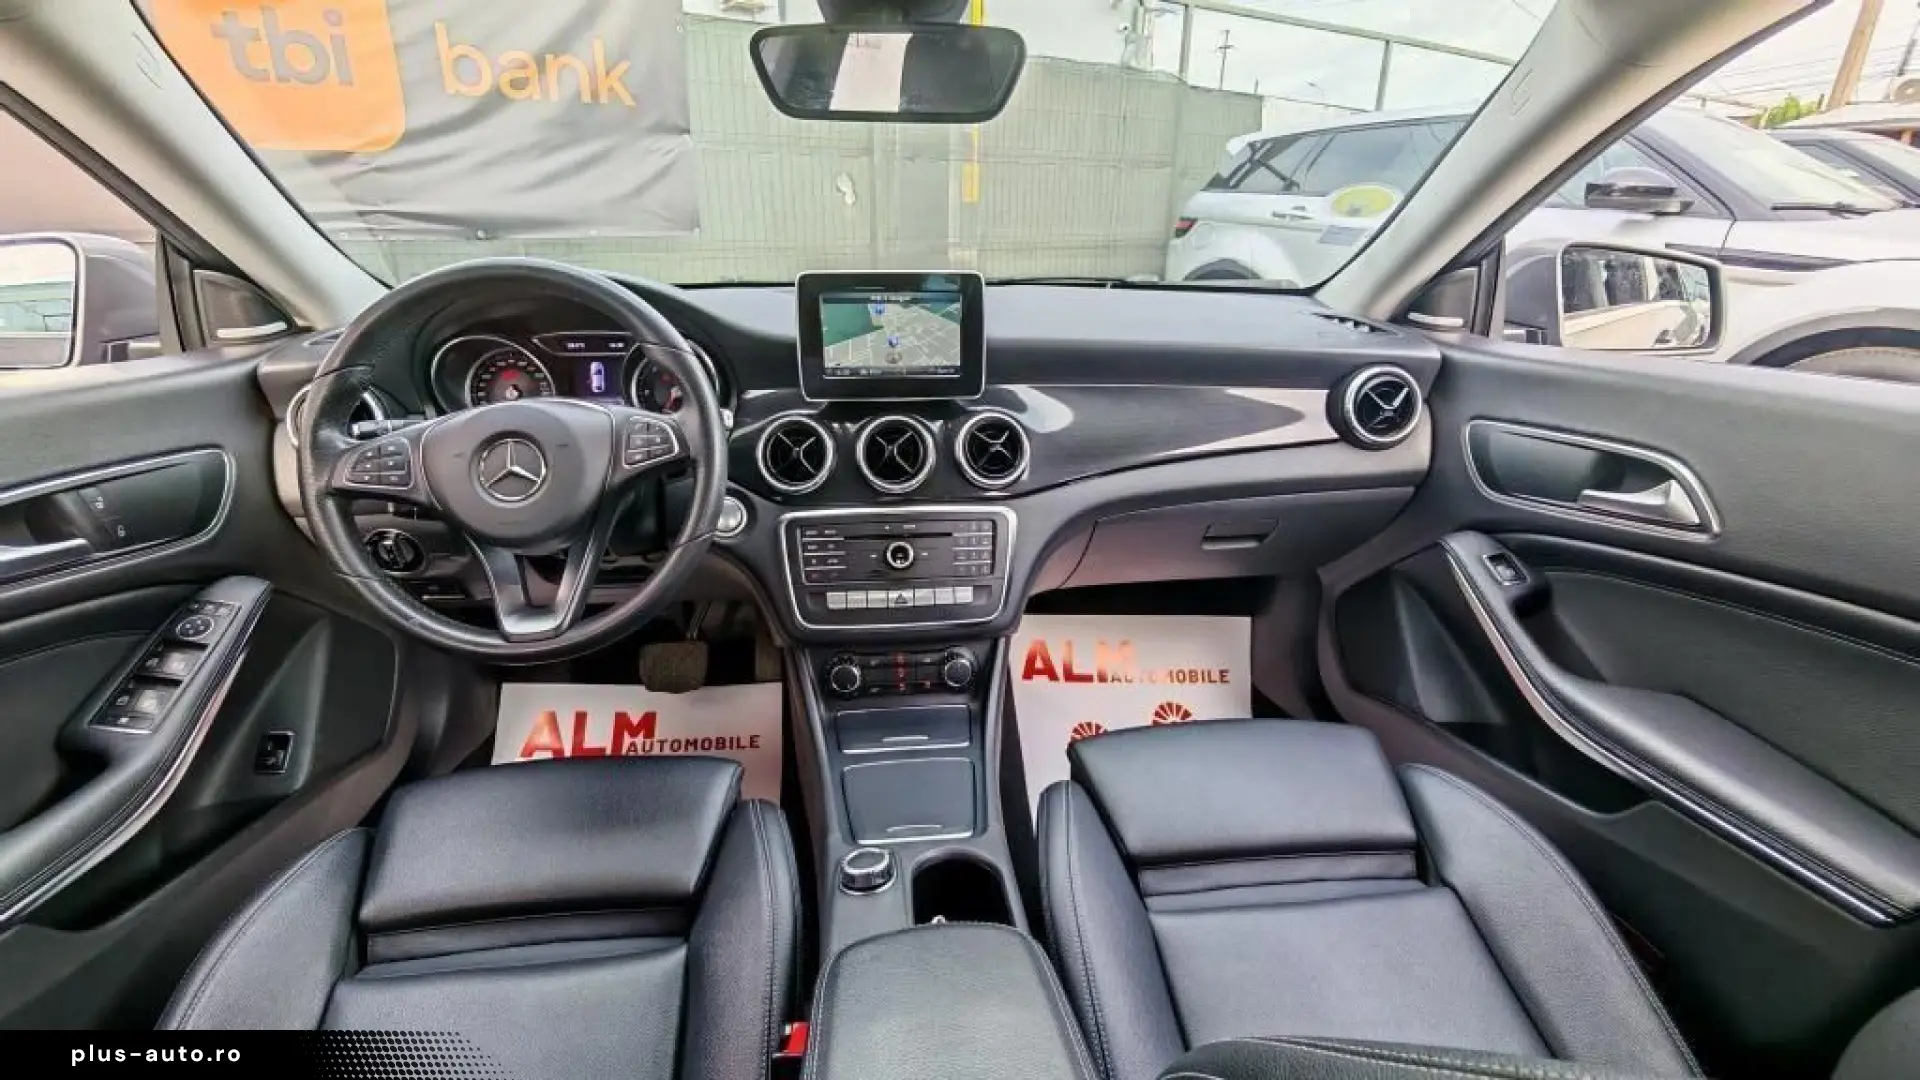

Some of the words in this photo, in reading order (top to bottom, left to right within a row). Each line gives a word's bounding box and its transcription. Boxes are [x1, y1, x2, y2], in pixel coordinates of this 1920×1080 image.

[210, 5, 354, 87] tbi
[434, 21, 637, 107] bank
[1021, 637, 1134, 684] ALM
[519, 710, 657, 759] ALM
[625, 734, 761, 755] AUTOMOBILE
